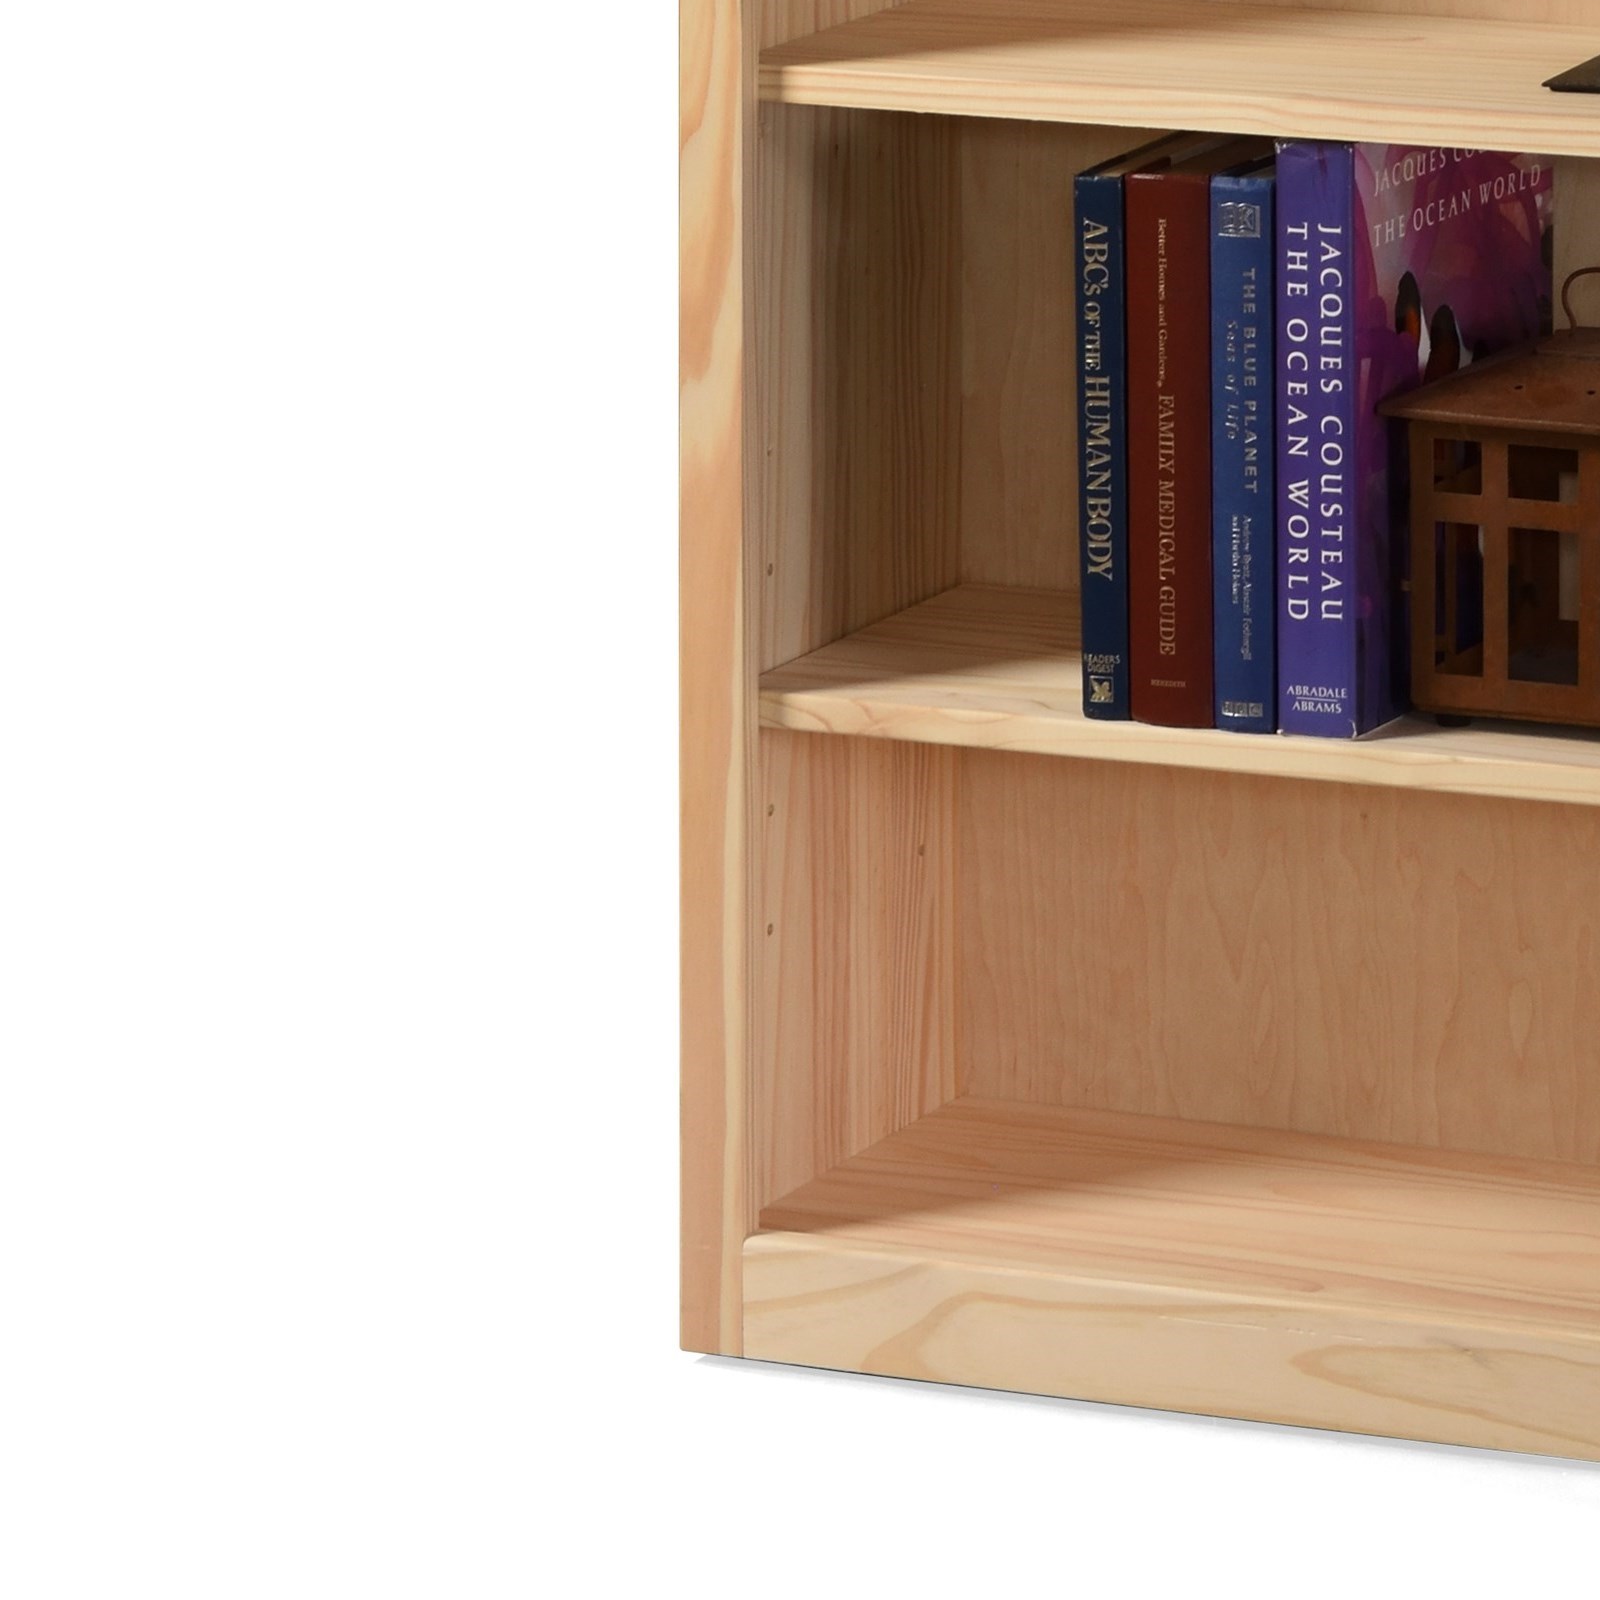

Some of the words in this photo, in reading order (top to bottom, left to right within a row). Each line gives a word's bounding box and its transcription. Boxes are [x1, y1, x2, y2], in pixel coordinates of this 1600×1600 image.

[1374, 148, 1447, 197] JACQUES
[1374, 215, 1406, 247] THE
[1413, 188, 1473, 232] OCEAN
[1479, 164, 1541, 205] WORLD
[1158, 218, 1168, 256] Better
[1287, 222, 1308, 297] THE
[1158, 258, 1168, 300] Homes
[1243, 268, 1255, 313] THE
[1318, 223, 1343, 393] JACQUES
[1084, 302, 1101, 328] OF
[1158, 303, 1168, 327] and
[1084, 331, 1101, 371] THE
[1243, 327, 1256, 387] BLUE
[1287, 318, 1308, 457] OCEAN
[1084, 376, 1112, 493] HUMAN
[1158, 395, 1175, 474] FAMILY
[1244, 400, 1258, 493] PLANET
[1086, 496, 1113, 581] BODY
[1158, 479, 1175, 580] MEDICAL
[1287, 479, 1309, 620] WORLD
[1320, 415, 1343, 620] COUSTEAU
[1159, 586, 1175, 655] GUIDE
[1087, 664, 1115, 674] DIGEST
[1287, 685, 1347, 698] ABRADALE
[1292, 701, 1342, 714] ABRAMS
